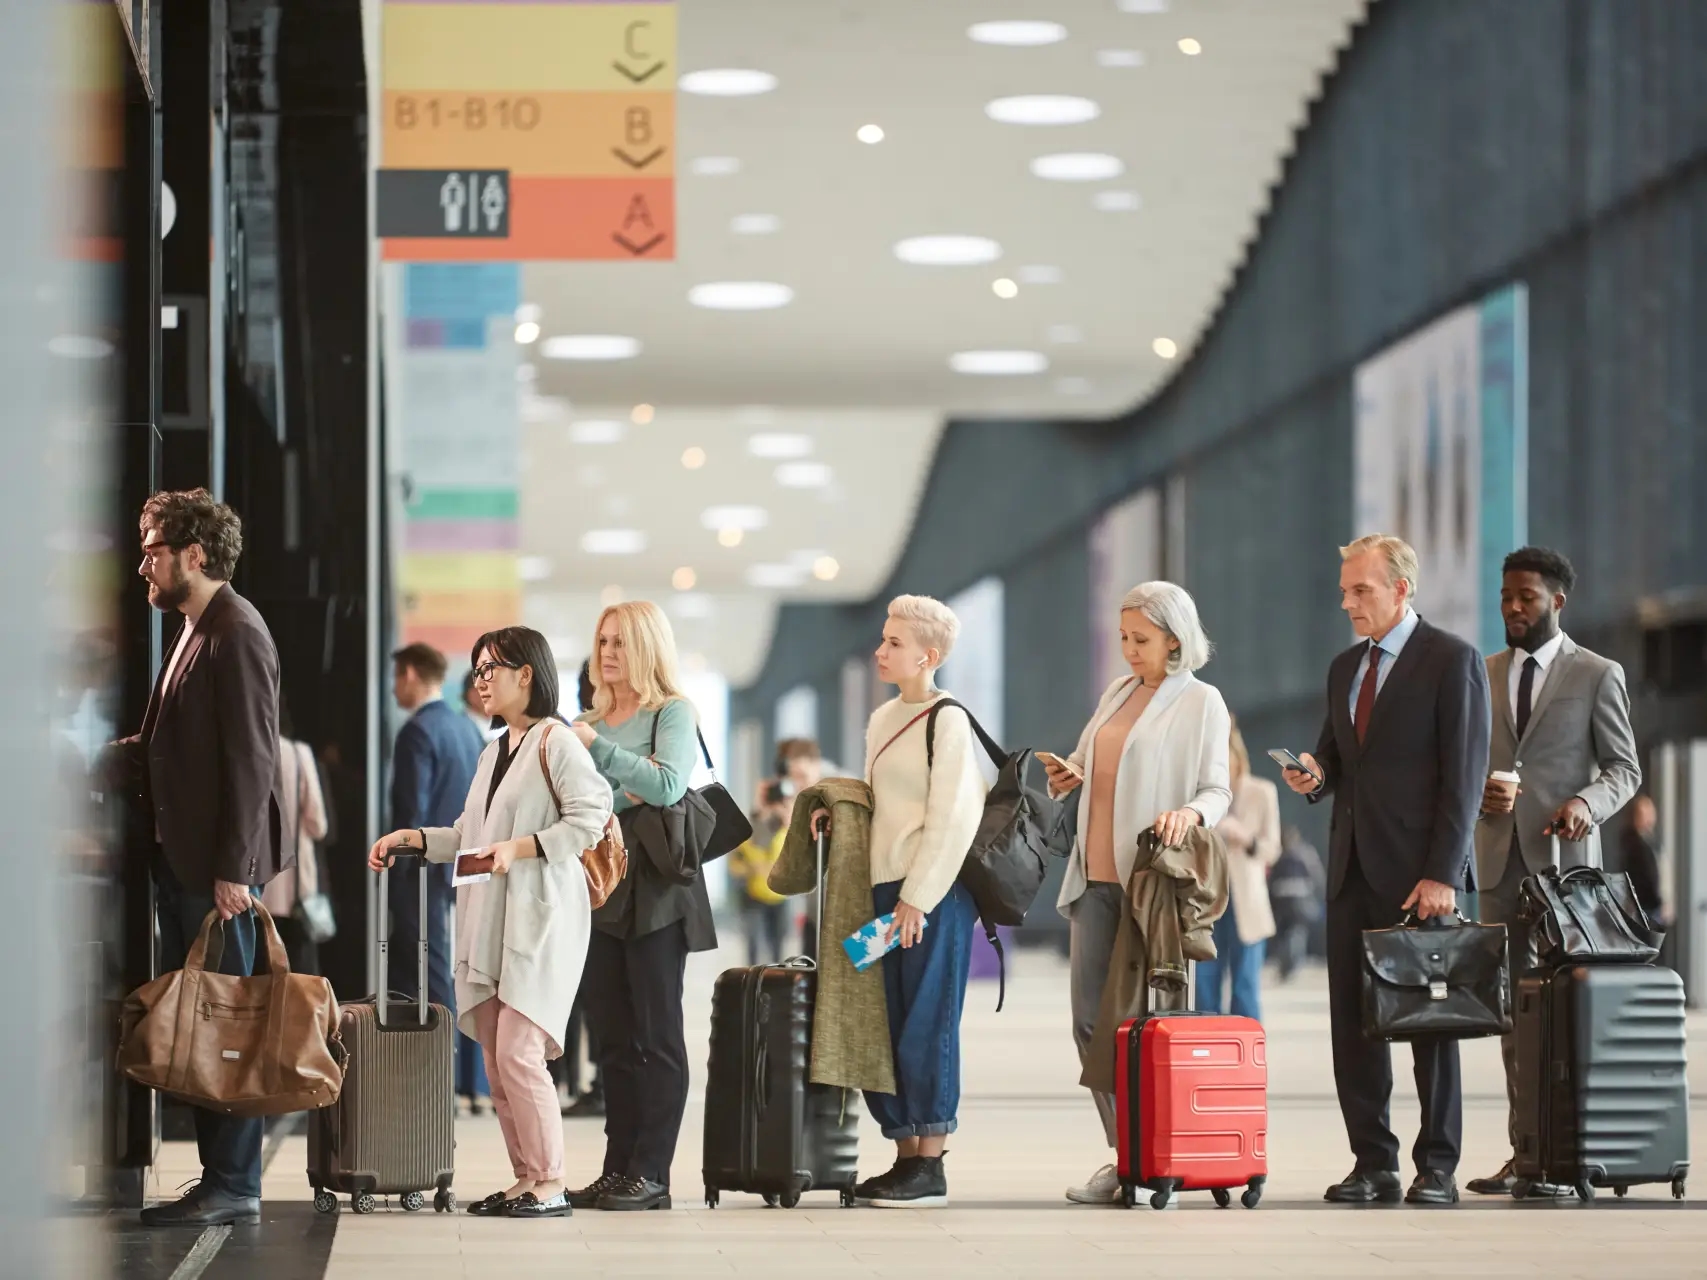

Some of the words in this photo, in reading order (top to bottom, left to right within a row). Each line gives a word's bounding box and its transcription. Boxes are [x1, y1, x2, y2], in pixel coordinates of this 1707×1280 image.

[624, 20, 652, 60] C
[394, 96, 542, 132] B1-B10
[624, 105, 654, 146] B
[622, 193, 655, 230] A
